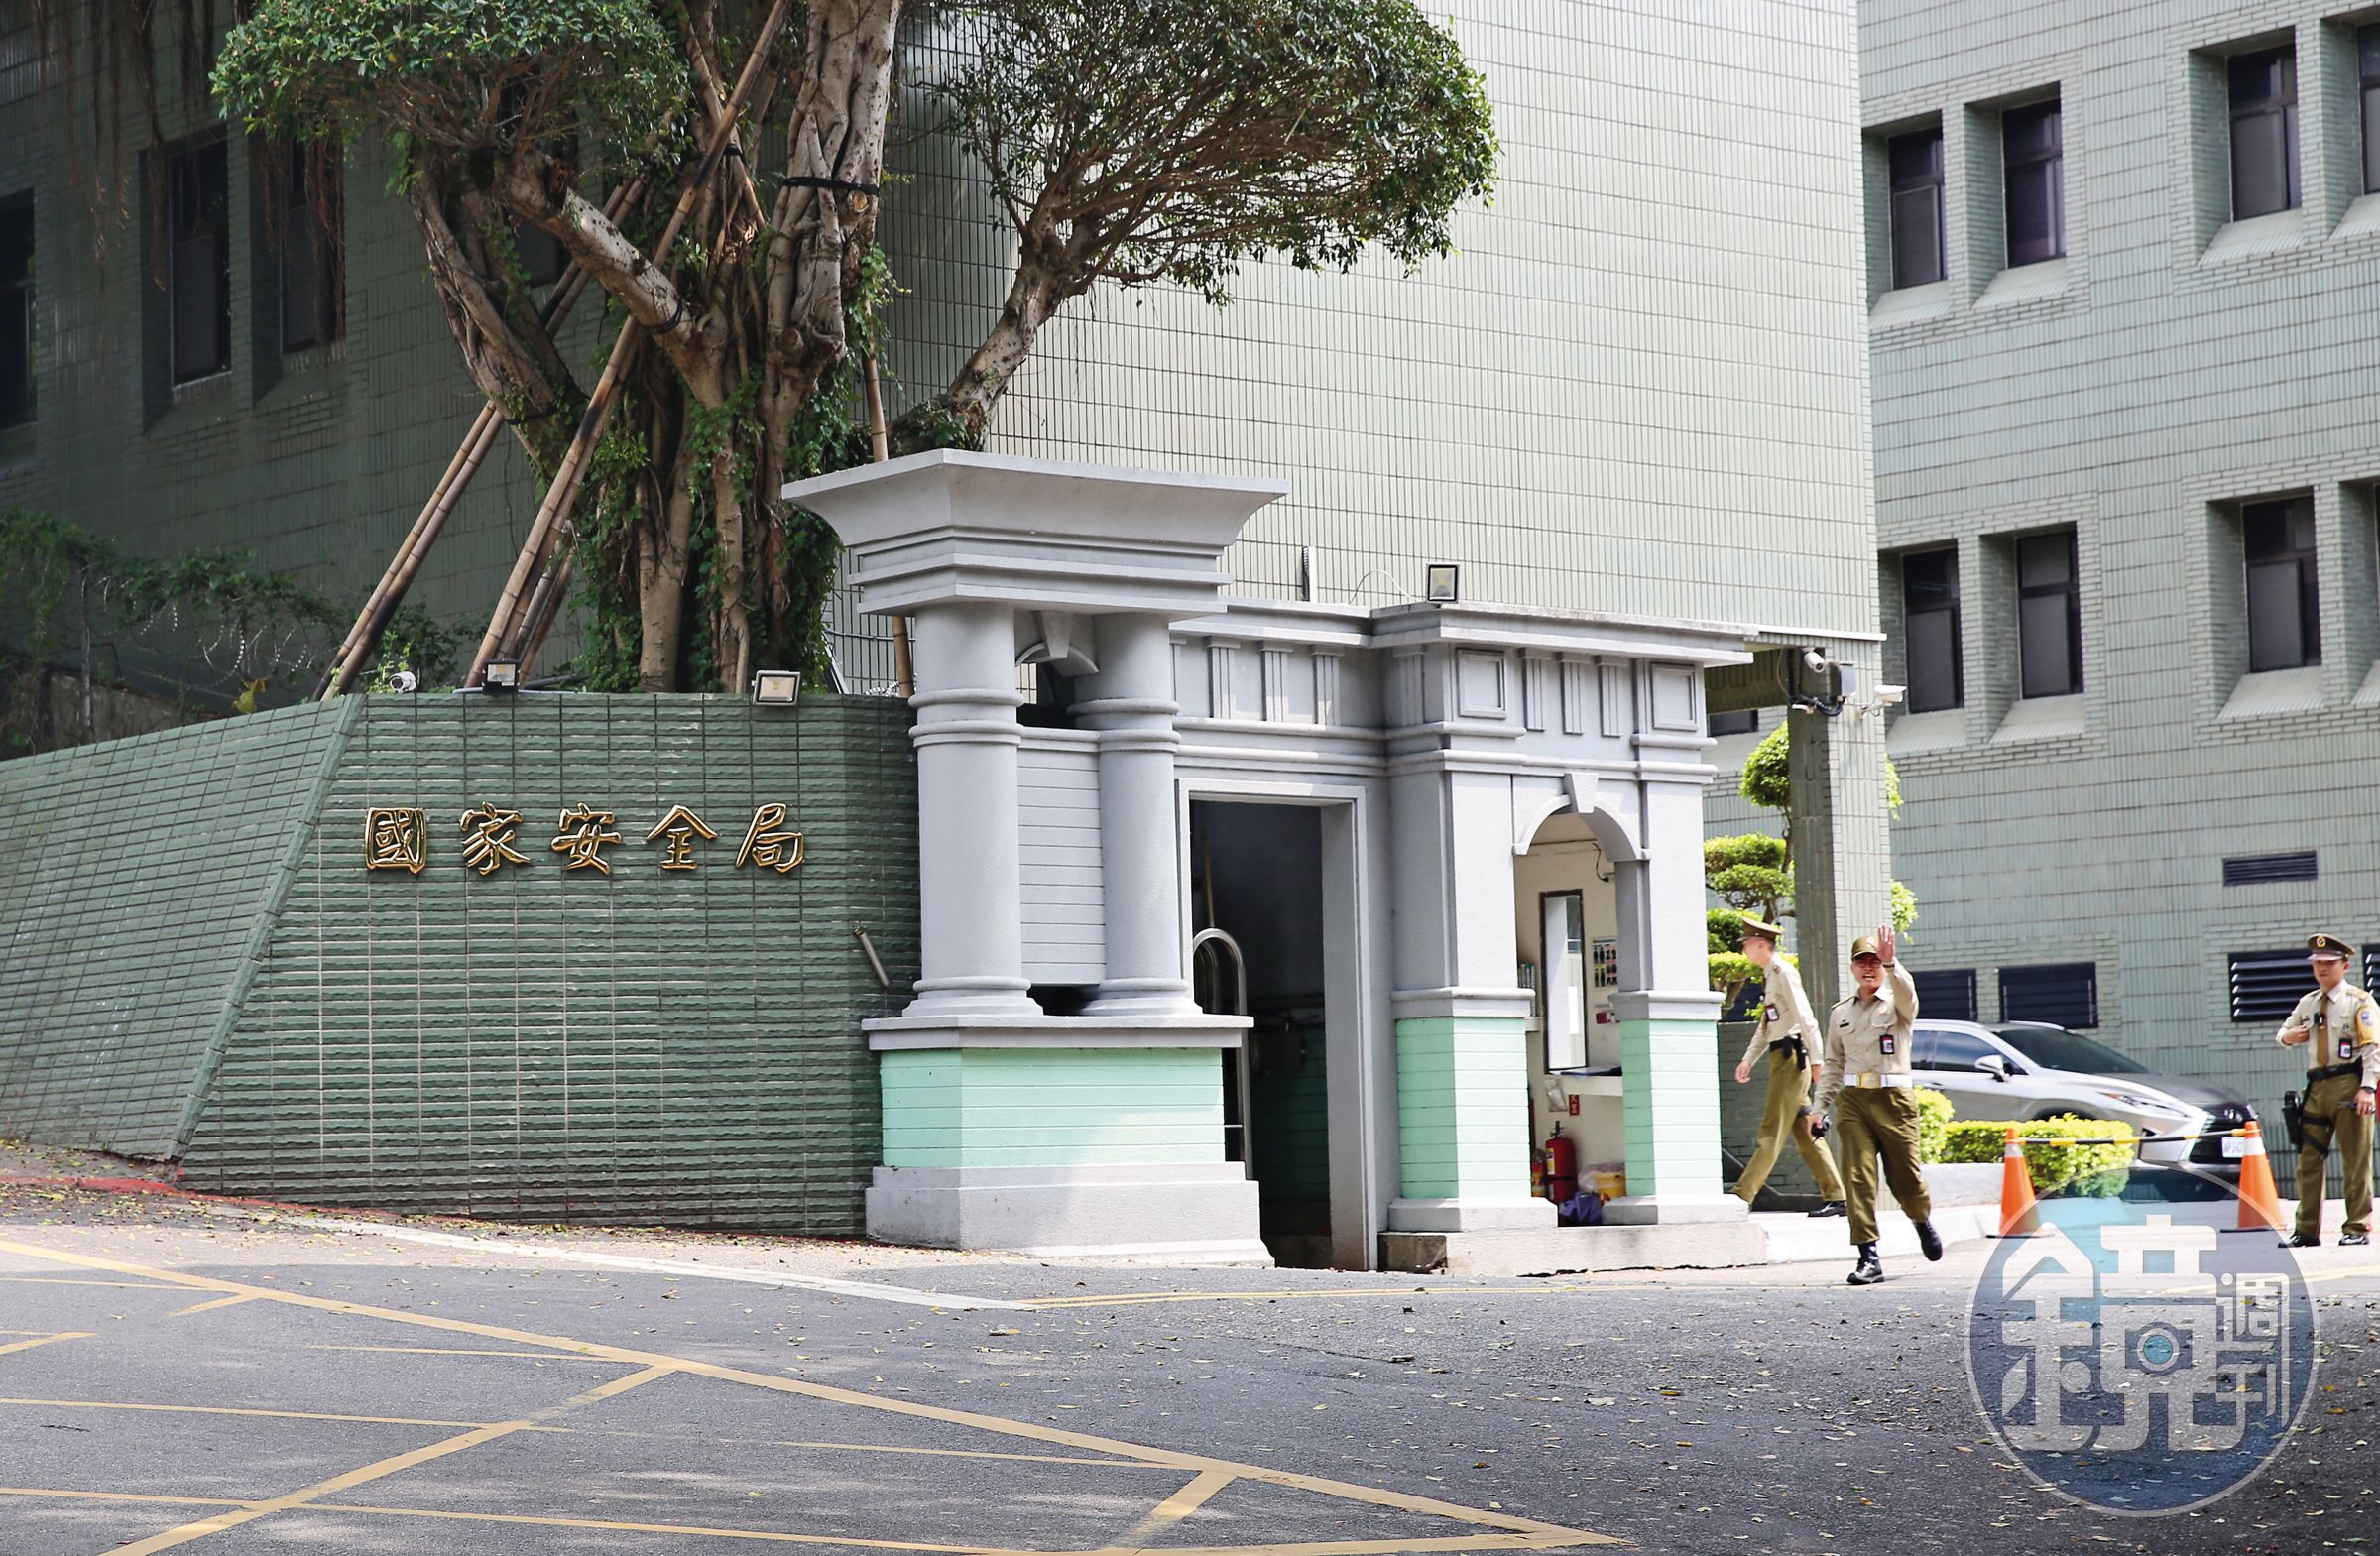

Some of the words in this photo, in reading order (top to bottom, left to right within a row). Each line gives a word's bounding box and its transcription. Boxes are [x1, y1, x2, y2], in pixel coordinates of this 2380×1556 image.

[365, 801, 804, 875] 國家安全局
